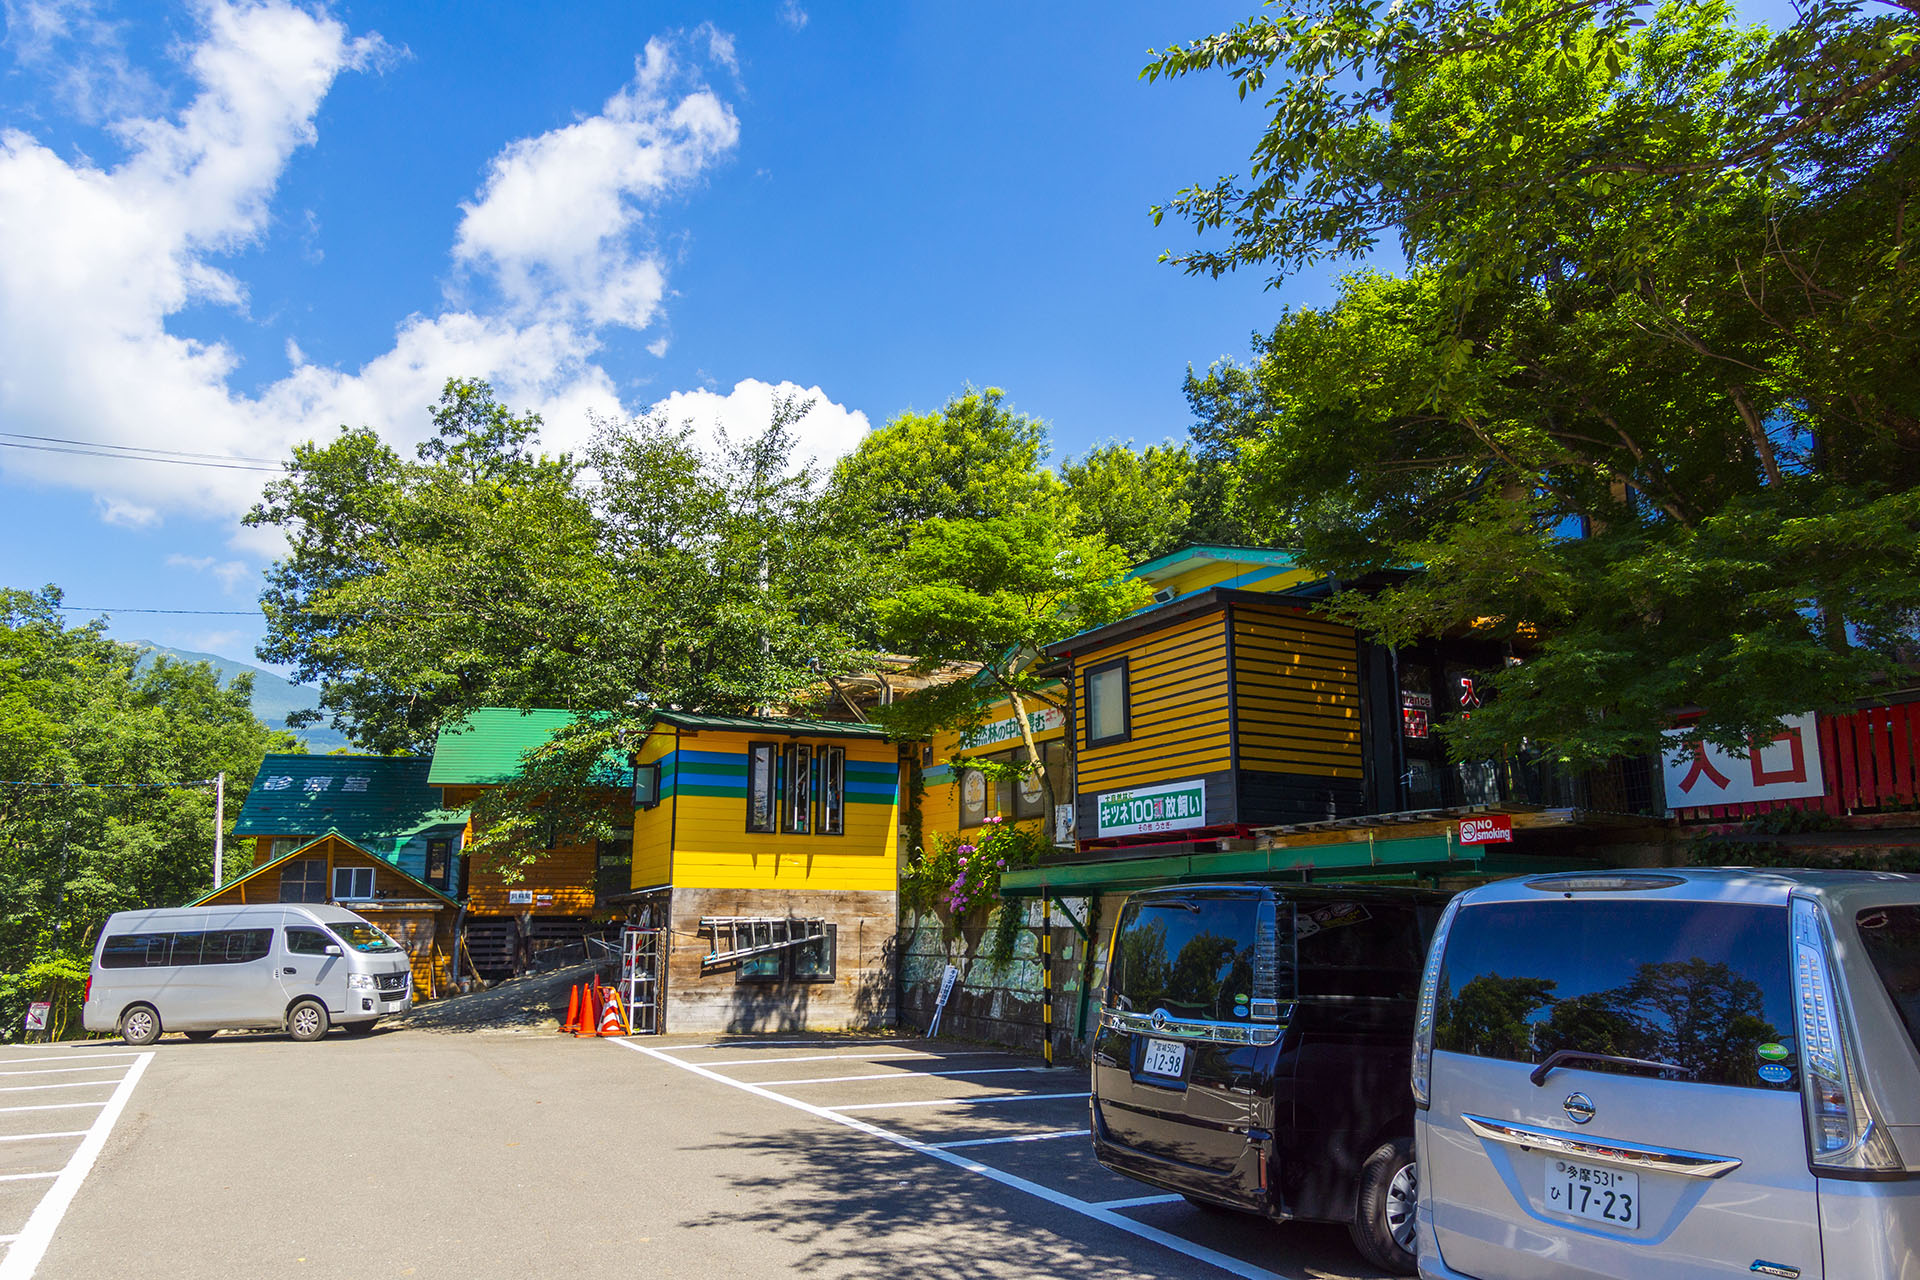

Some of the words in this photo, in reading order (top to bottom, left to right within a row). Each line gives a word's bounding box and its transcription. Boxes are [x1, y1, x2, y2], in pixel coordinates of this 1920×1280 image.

[1678, 727, 1807, 794] 入口
[1476, 827, 1511, 841] smoking
[1477, 819, 1493, 830] NO
[1514, 1132, 1653, 1166] SERENA
[1551, 1186, 1561, 1200] ひ
[1568, 1182, 1632, 1222] 17-23
